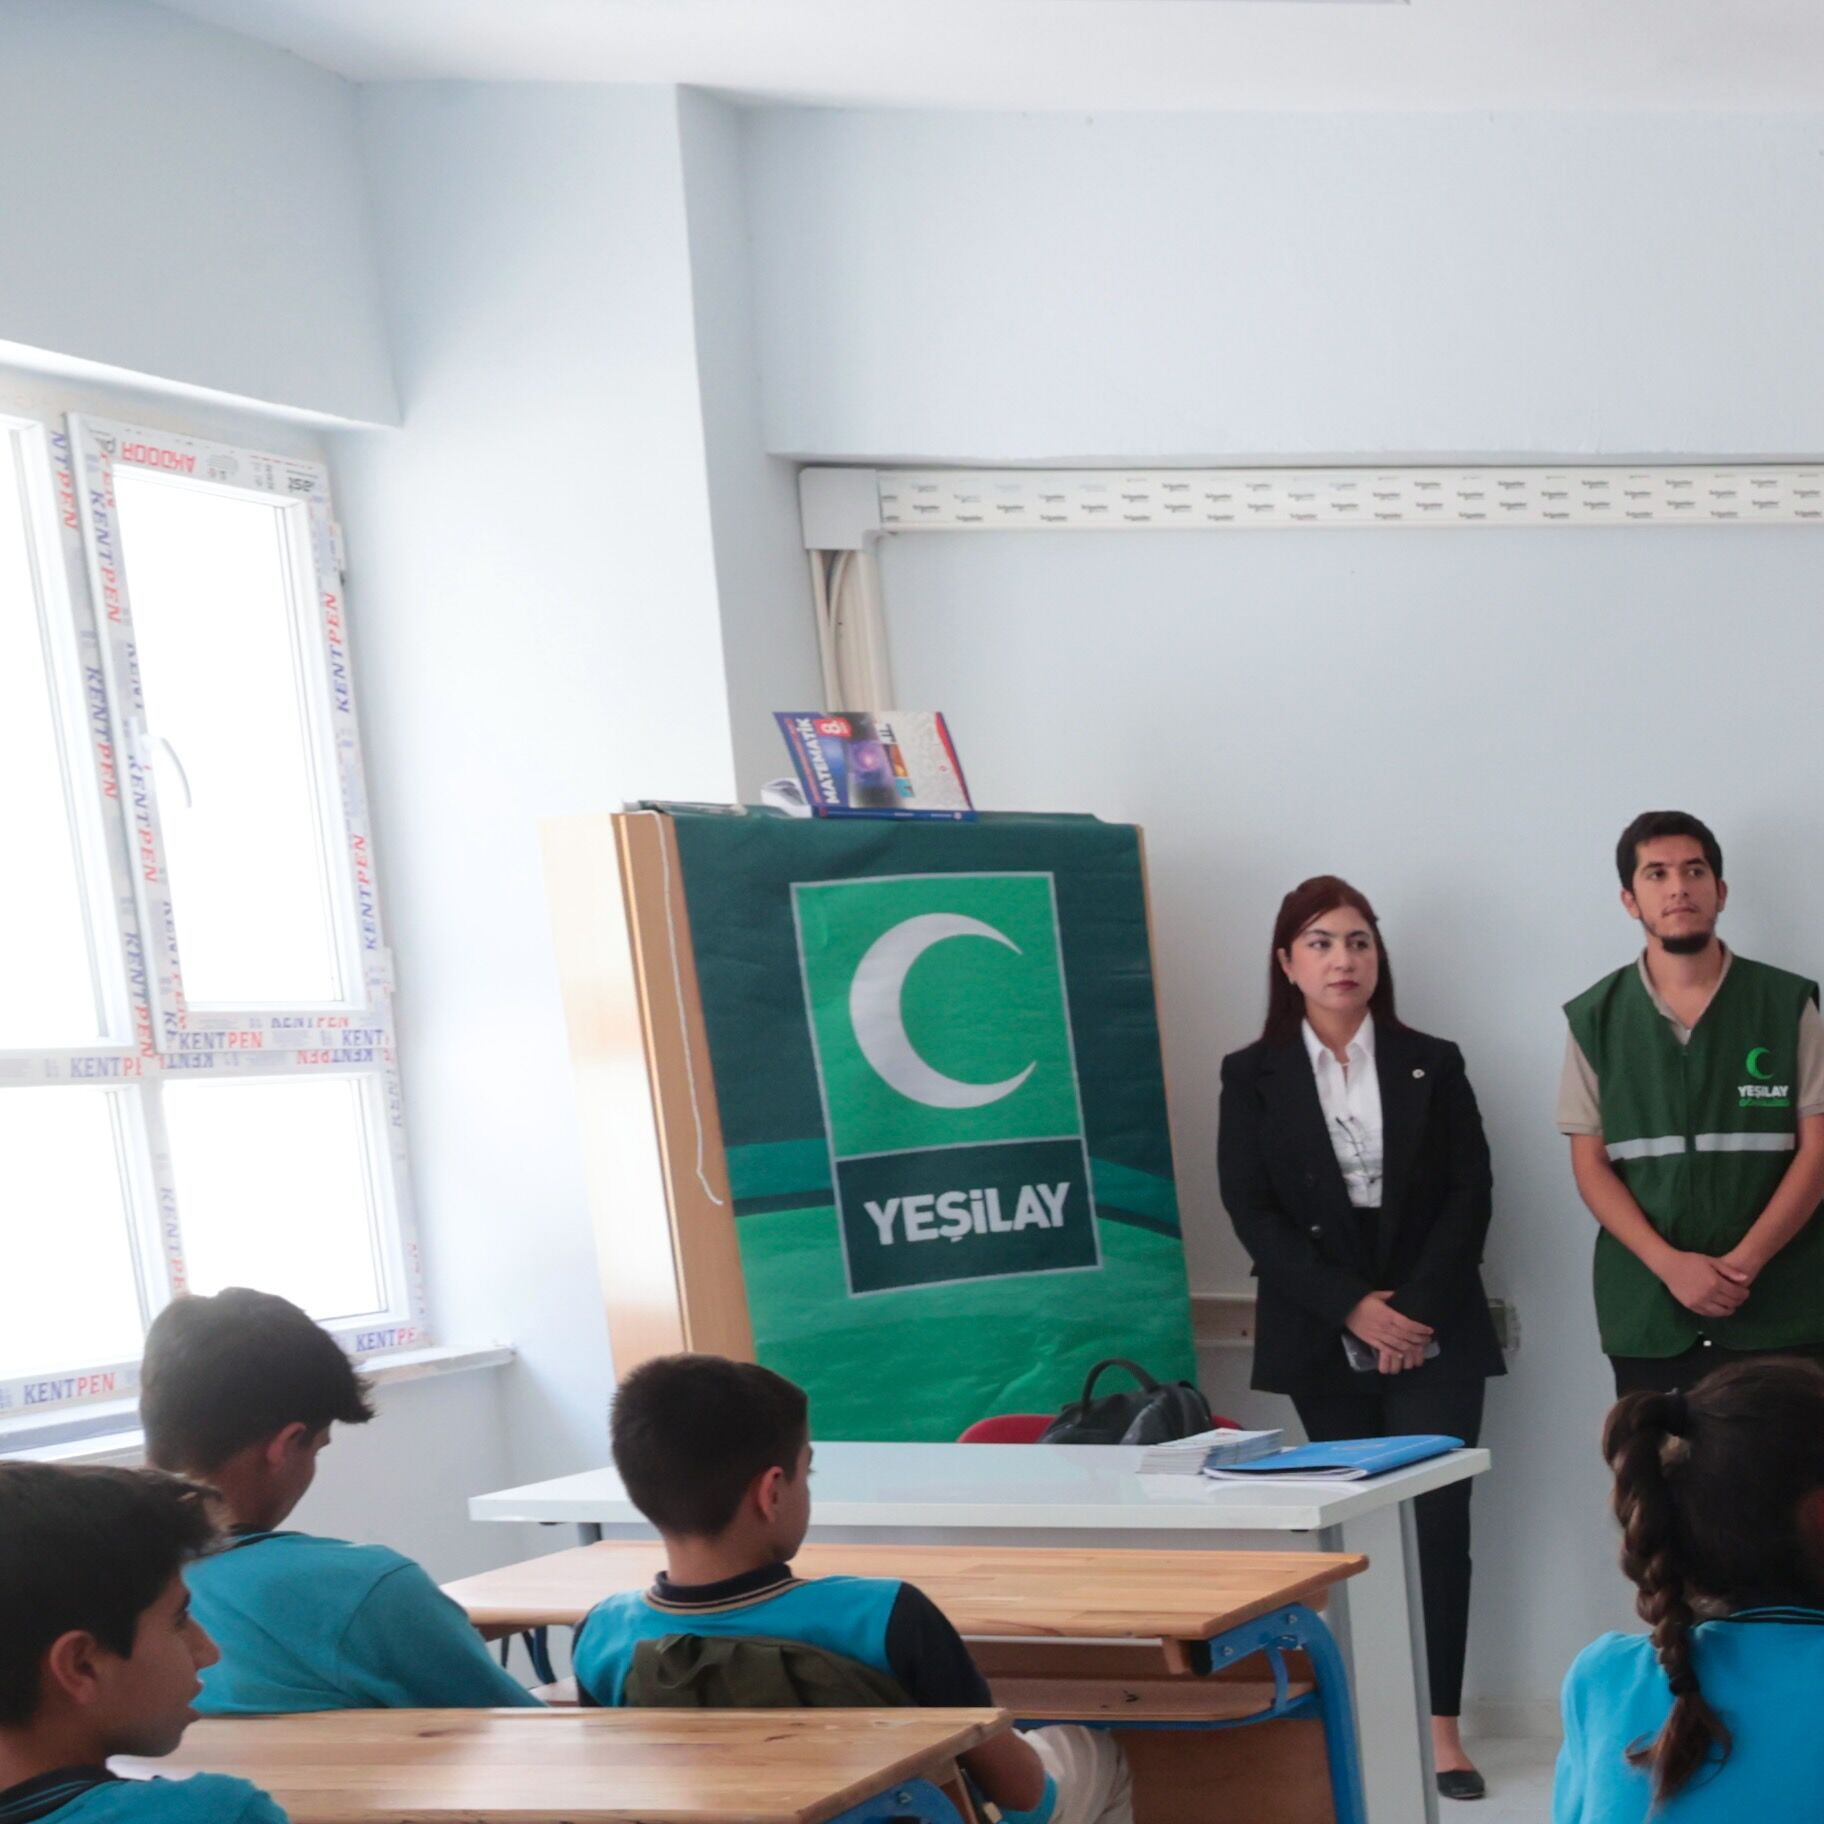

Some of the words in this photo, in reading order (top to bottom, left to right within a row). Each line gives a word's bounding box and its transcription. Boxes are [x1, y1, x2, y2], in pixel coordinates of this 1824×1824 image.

[89, 489, 123, 624] KENTPEN
[322, 591, 350, 713] KENTPEN
[85, 664, 118, 802] KENTPEN
[795, 717, 841, 805] MATEMATİK
[351, 833, 377, 952] KENTPEN
[178, 1031, 263, 1050] KENTPEN
[341, 1029, 390, 1047] KENT
[863, 1181, 1071, 1246] YEŞİLAY
[23, 1371, 116, 1406] KENTPEN
